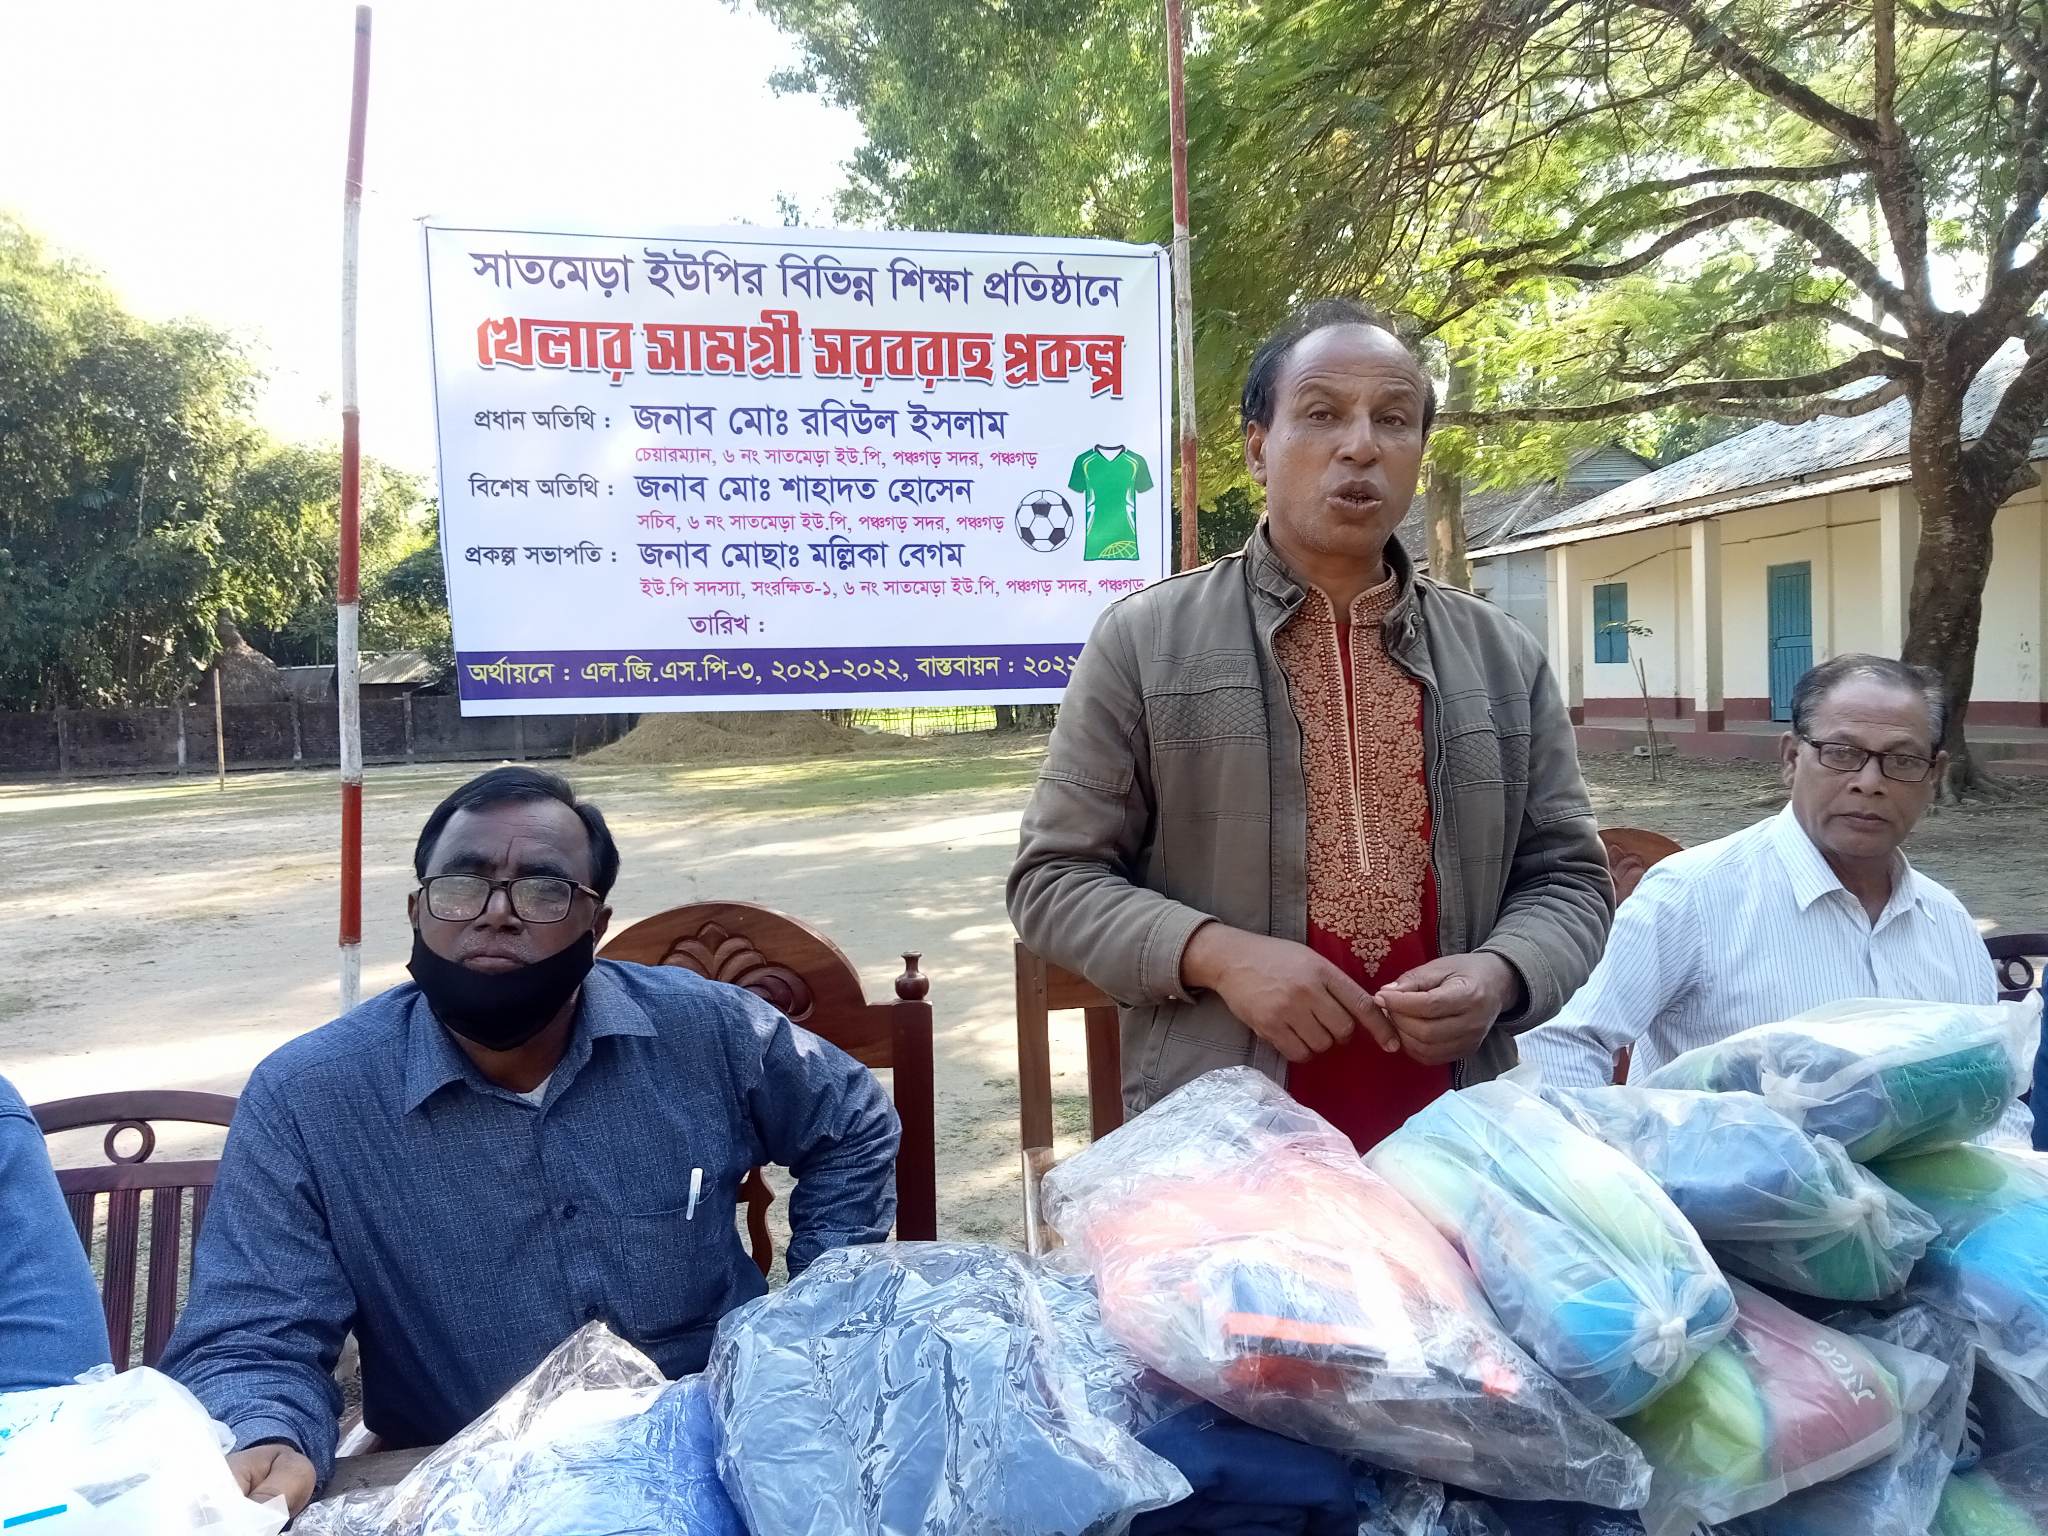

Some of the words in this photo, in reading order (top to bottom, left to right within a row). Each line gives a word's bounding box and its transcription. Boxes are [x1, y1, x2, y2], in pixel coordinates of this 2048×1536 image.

[468, 250, 634, 298] সাতমেড়া
[643, 247, 767, 298] ইউপির
[776, 253, 879, 307] বিভিন্ন
[886, 257, 974, 305] শিক্ষা
[984, 260, 1124, 308] প্রতিষ্ঠানে
[476, 316, 635, 383] খেলার
[642, 308, 804, 377] সামগ্রী
[810, 327, 994, 391] সরবরাহ
[1003, 333, 1126, 398] প্রকল্প
[474, 409, 527, 430] প্রধান
[531, 405, 596, 430] অতিথি
[629, 403, 718, 436] জনাব
[729, 404, 788, 437] মোঃ
[797, 399, 900, 438] রবিউল
[906, 400, 1010, 442] ইসলাম
[467, 472, 530, 498] বিশেষ
[535, 473, 599, 498] অতিথি
[633, 473, 709, 502] জনাব
[719, 475, 770, 502] মোঃ
[778, 475, 879, 506] শাহাদত
[889, 478, 975, 506] হোসেন
[465, 545, 518, 566] প্রকল্প
[523, 541, 603, 565] সভাপতি
[636, 540, 712, 568] জনাব
[722, 541, 799, 571] মোছাঃ
[807, 535, 890, 570] মল্লিকা
[899, 541, 966, 568] বেগম
[688, 610, 750, 635] তারিখ
[467, 656, 555, 684] অর্থায়নে
[772, 660, 908, 681] ২০২১-২০২২,
[915, 656, 1001, 677] বাস্তবায়ন
